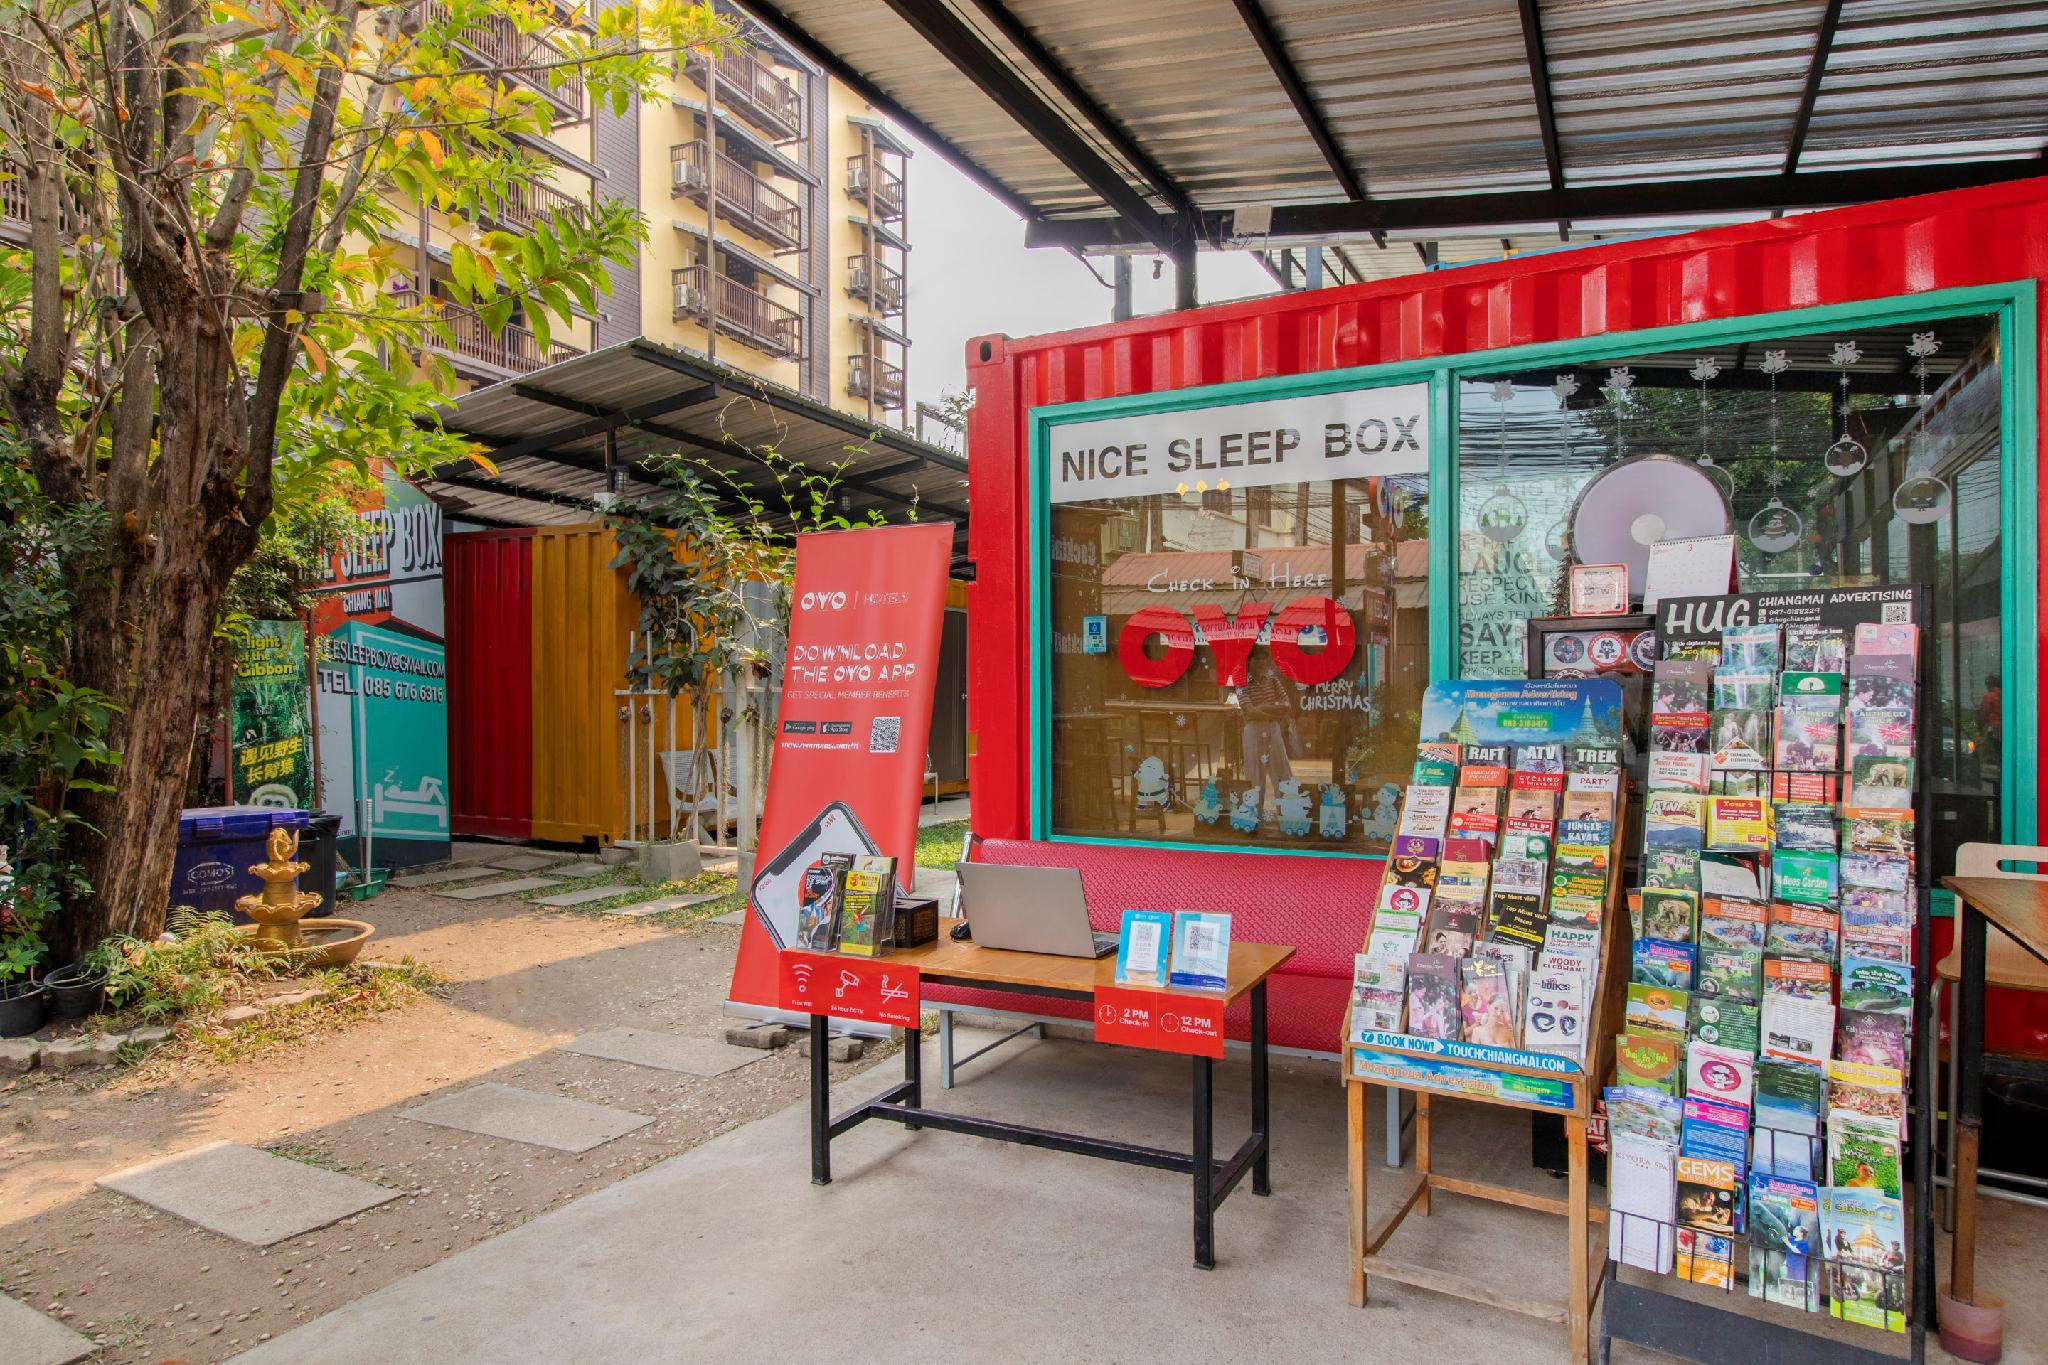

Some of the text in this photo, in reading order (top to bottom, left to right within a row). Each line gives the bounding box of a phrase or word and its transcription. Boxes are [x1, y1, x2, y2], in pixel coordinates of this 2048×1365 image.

[1062, 415, 1421, 482] NICE SLEEP BOX
[343, 587, 391, 614] CHIANG MAI
[801, 591, 846, 611] OYO
[1665, 589, 1912, 635] HUG CHIANGMAI ADVERTISING
[1118, 595, 1356, 689] OYO
[1459, 623, 1512, 648] SAY
[252, 651, 270, 661] the
[793, 642, 904, 661] DOWNLOAD
[1459, 651, 1502, 664] KEEP
[238, 662, 293, 678] Gibbon
[792, 664, 916, 683] THE OYO APP
[363, 676, 391, 699] 085
[395, 680, 417, 702] 676
[420, 684, 443, 704] 6316
[1315, 678, 1354, 695] MERRY
[1300, 694, 1371, 712] CHRISTMAS
[240, 736, 303, 767] 遇见野生
[1468, 747, 1506, 761] RAFT
[1527, 745, 1556, 761] ATV
[1577, 749, 1618, 763] TREK
[1519, 775, 1560, 783] CYCLING
[1650, 799, 1679, 816] ATV
[1568, 832, 1600, 841] KAYAK
[1783, 876, 1827, 889] Bees Garden
[1518, 908, 1533, 917] Most
[1552, 930, 1594, 942] HAPPY
[1549, 957, 1582, 966] WOODY
[1124, 1008, 1149, 1020] 2 PM
[1180, 1016, 1211, 1028] 12 PM
[1119, 1017, 1150, 1028] Check-in
[1181, 1026, 1218, 1037] Check-out
[1377, 1033, 1405, 1048] BOOK
[1408, 1038, 1435, 1054] NOW!
[1447, 1043, 1567, 1073] TOUCHCHIANGMAI.COM
[1654, 1161, 1669, 1171] SPA
[1677, 1159, 1733, 1182] GEMS
[1835, 1203, 1877, 1217] Gibbon
